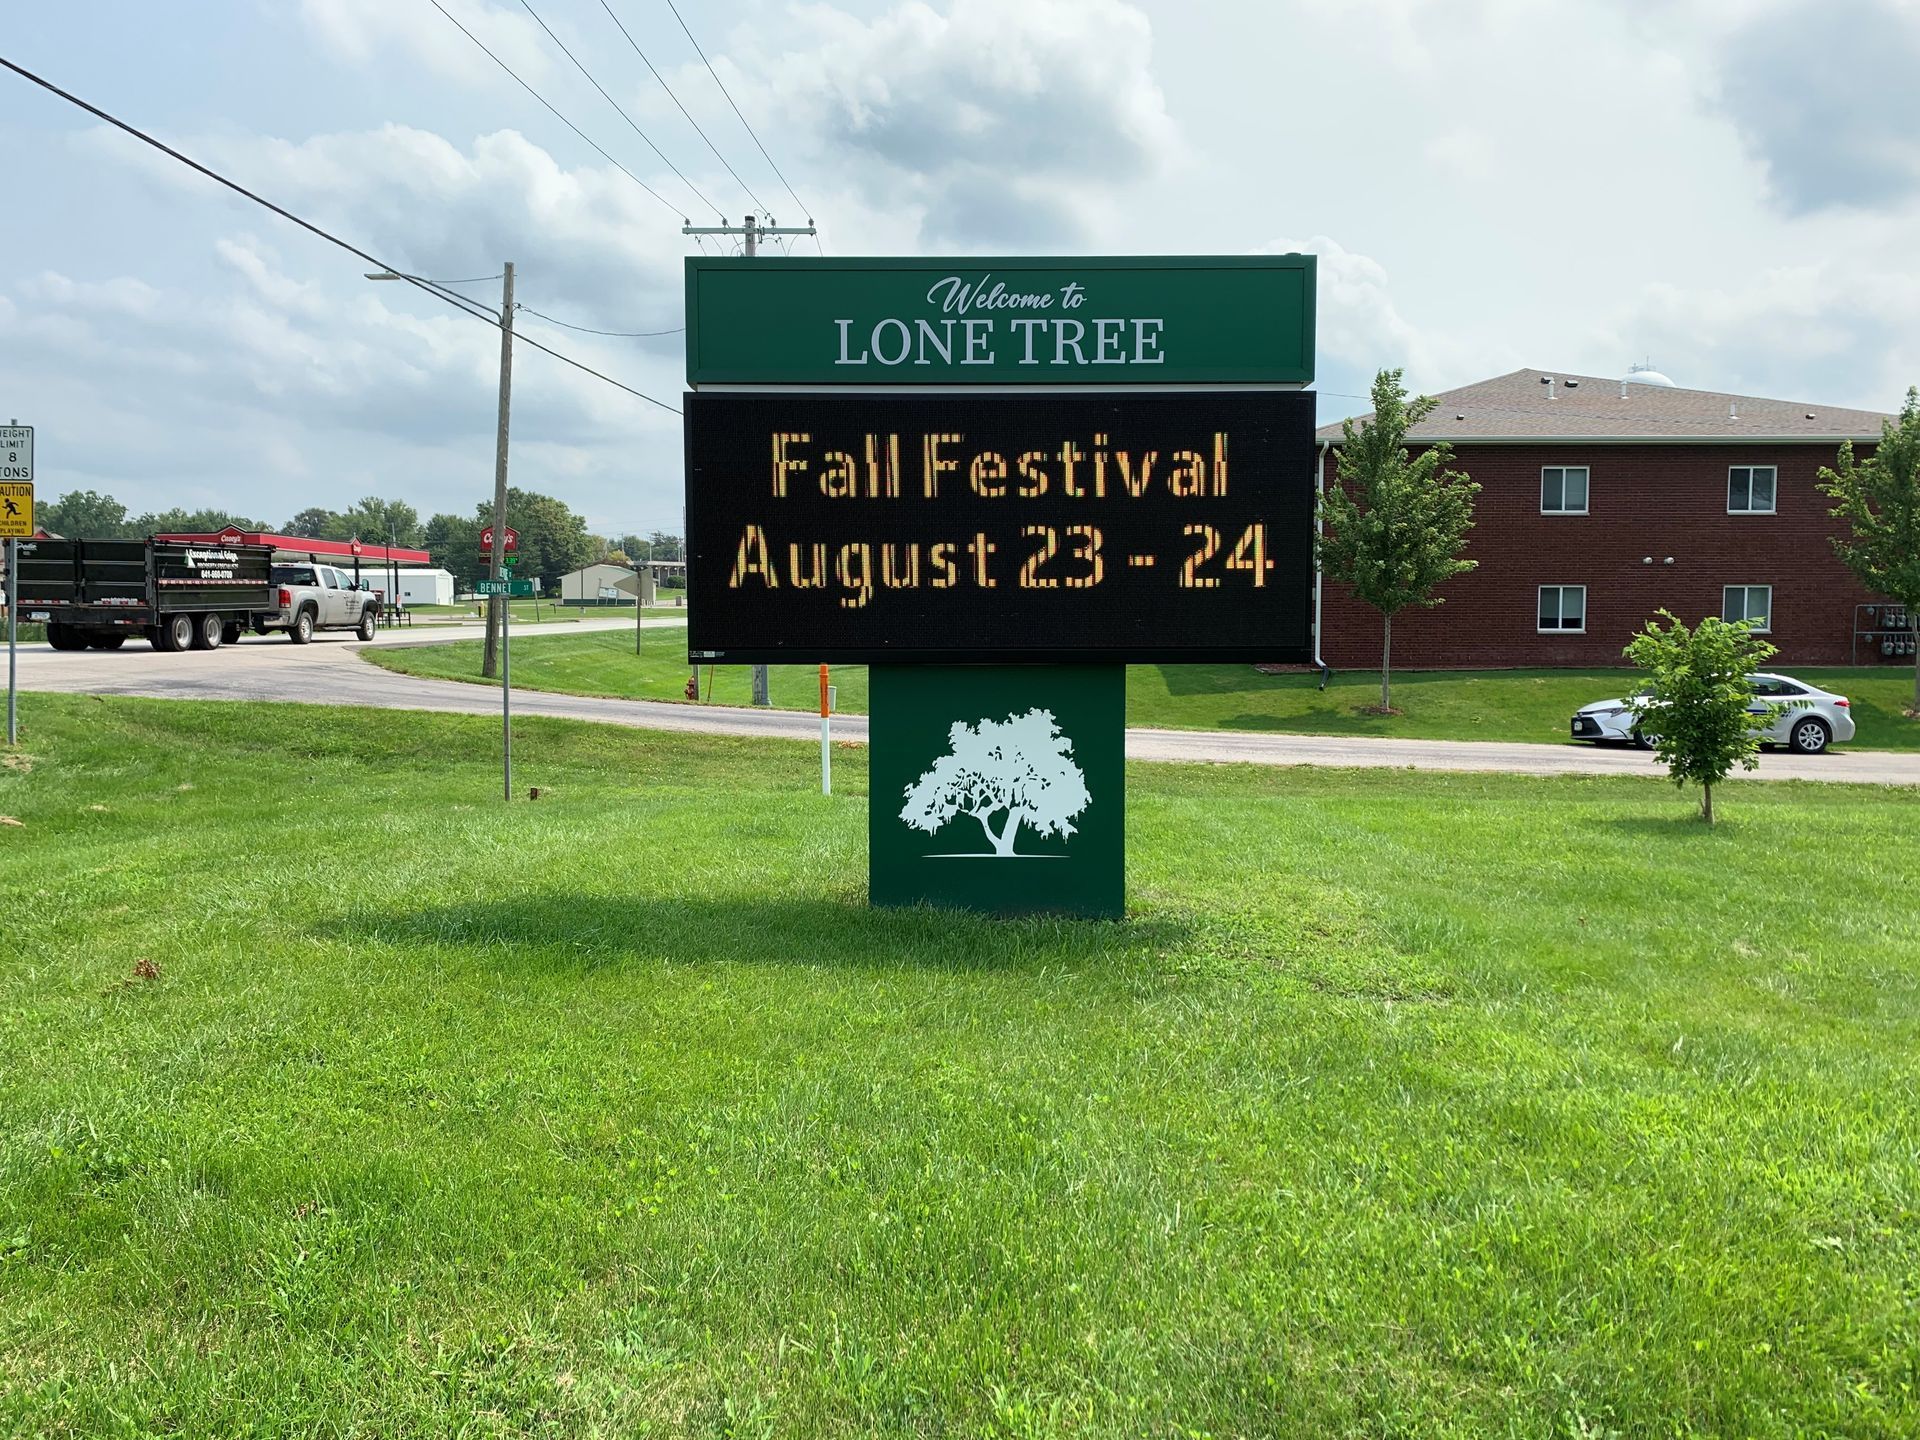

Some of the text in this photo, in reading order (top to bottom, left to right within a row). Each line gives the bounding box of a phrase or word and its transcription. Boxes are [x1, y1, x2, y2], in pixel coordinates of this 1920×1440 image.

[926, 273, 1087, 315] Welcome to
[834, 318, 1165, 365] LONE TREE
[0, 440, 24, 448] LIMIT
[8, 452, 17, 462] 8
[771, 432, 1228, 499] Fall Festival
[0, 485, 31, 497] AUTION
[484, 533, 514, 545] Cay's
[729, 523, 1276, 609] August 23 - 24
[480, 582, 512, 593] BENNET
